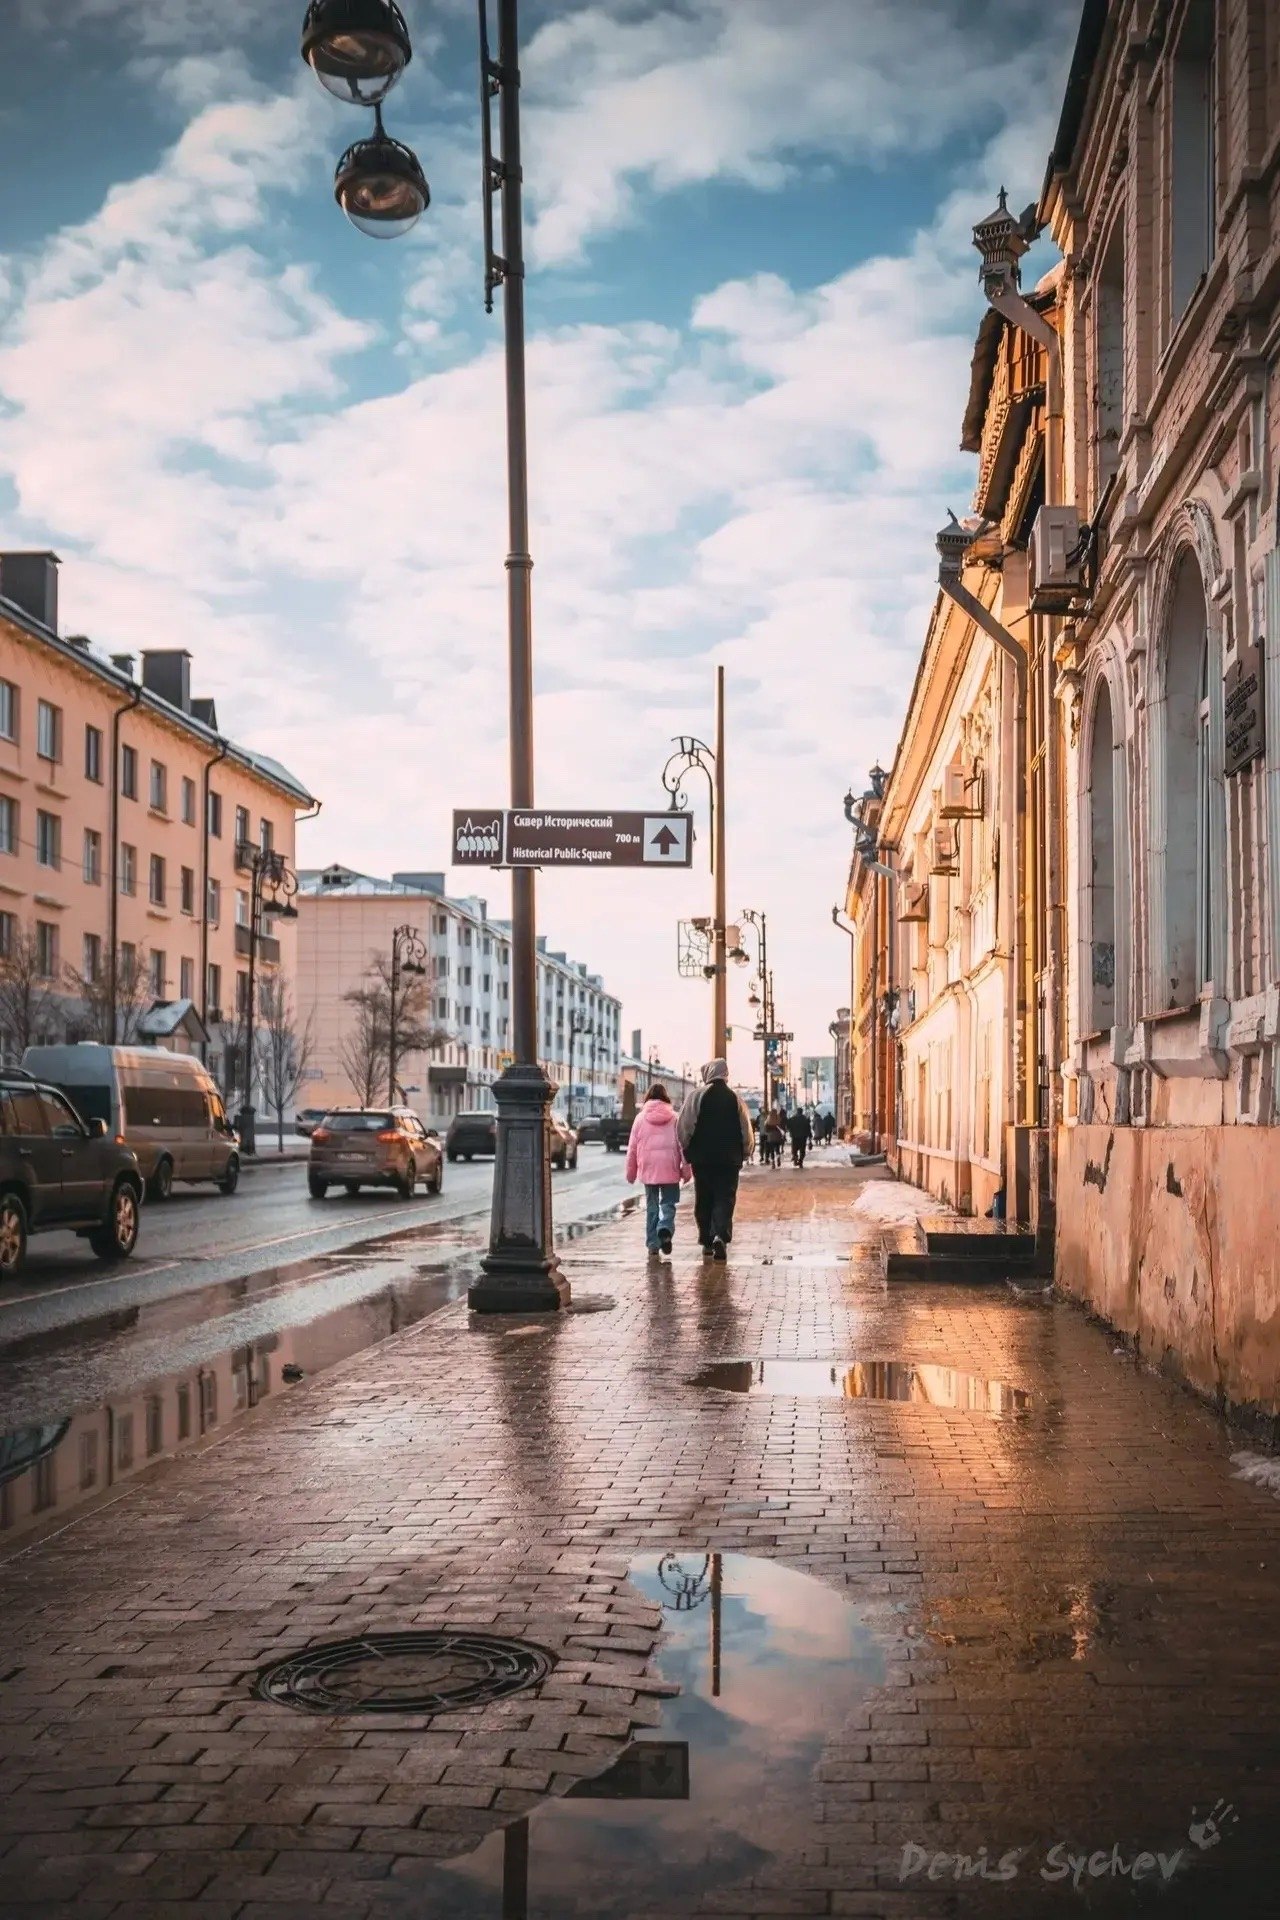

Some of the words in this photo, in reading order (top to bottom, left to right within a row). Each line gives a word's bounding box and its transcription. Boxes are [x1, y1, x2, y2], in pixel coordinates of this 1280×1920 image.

[514, 815, 543, 829] Сквер
[544, 815, 613, 830] Исторический
[615, 833, 632, 843] 700
[512, 847, 553, 859] Historical
[554, 848, 581, 860] Public
[581, 848, 612, 862] Square
